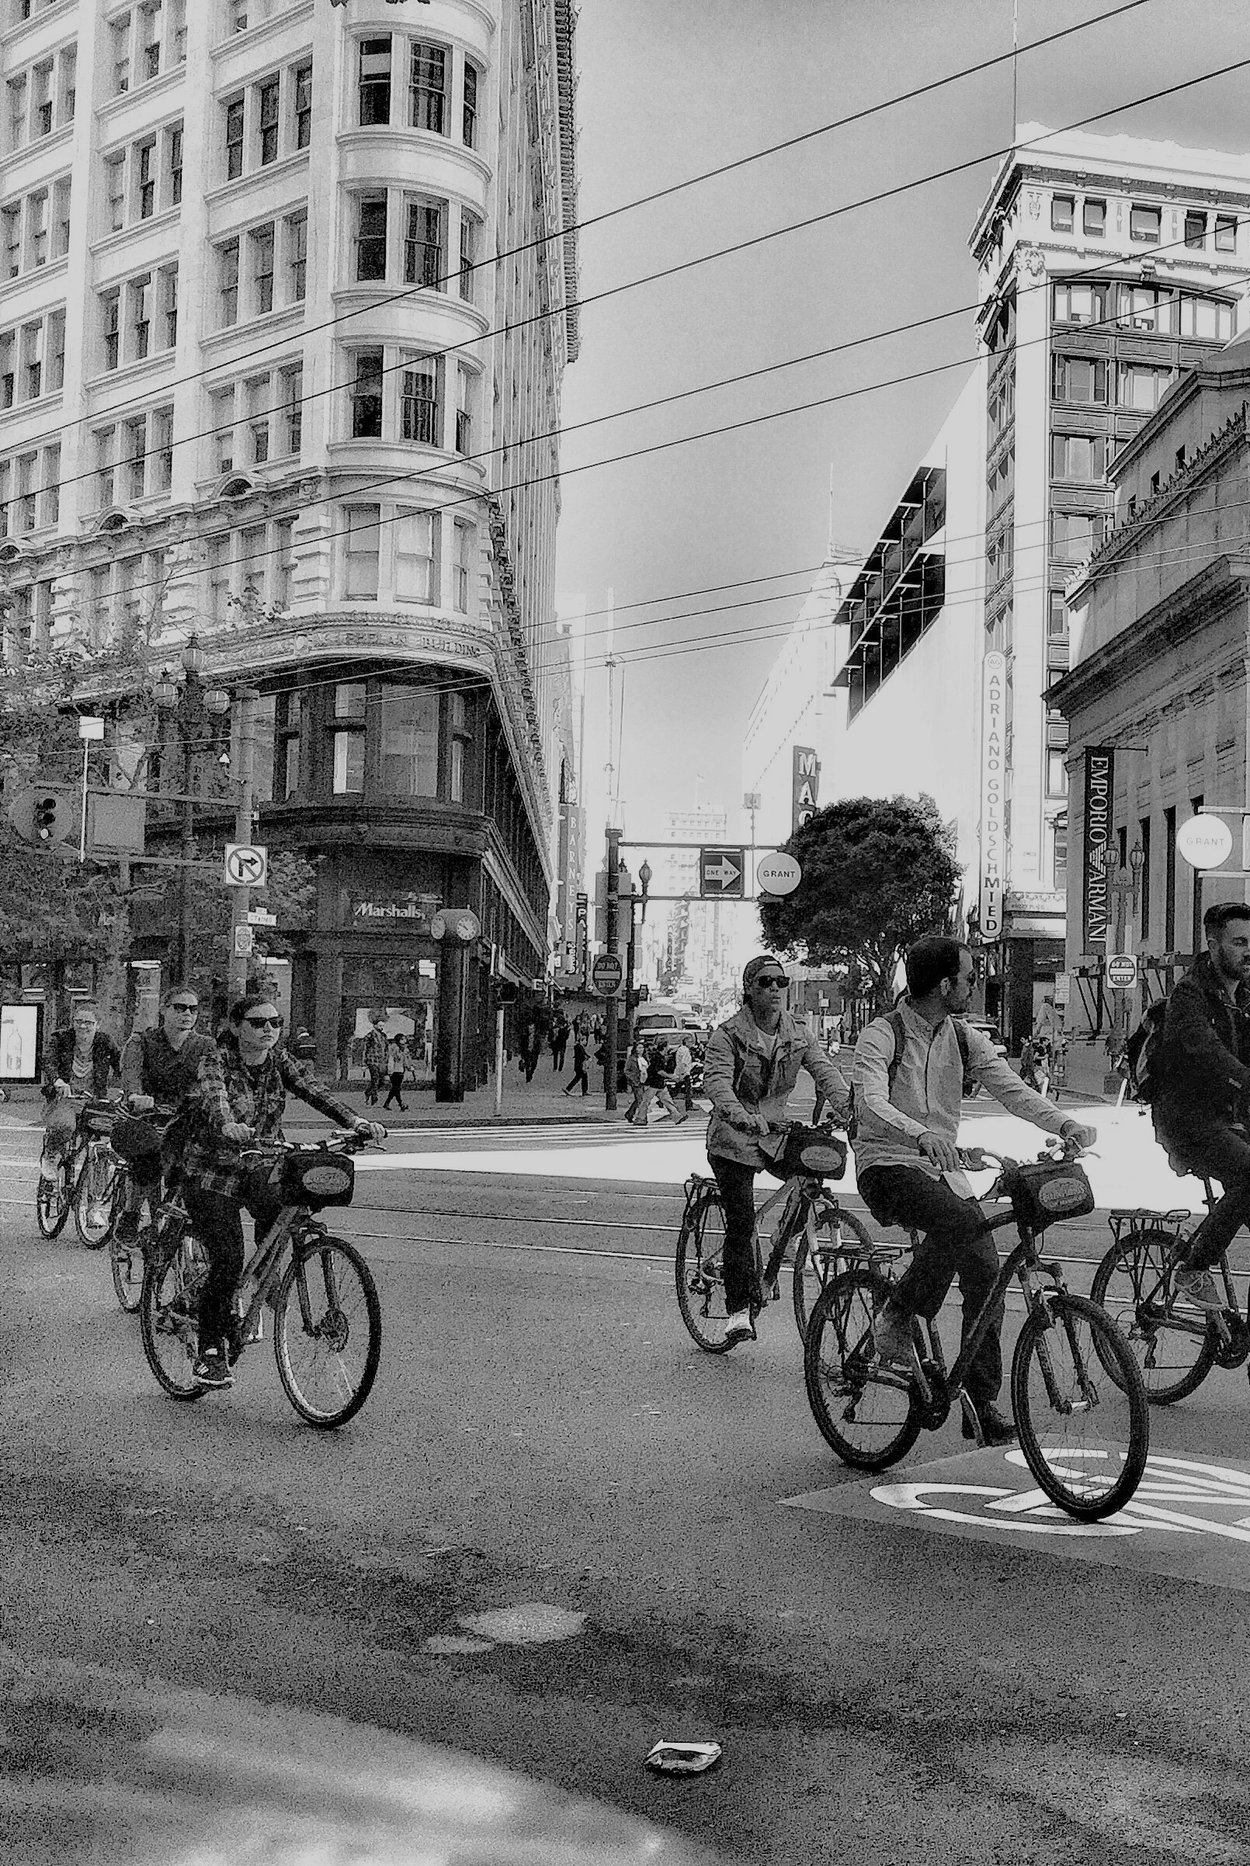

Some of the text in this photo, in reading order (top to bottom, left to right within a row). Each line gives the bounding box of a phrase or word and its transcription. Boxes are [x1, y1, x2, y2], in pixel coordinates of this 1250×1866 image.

[984, 675, 1001, 931] ADRIANO GOLDSCHMIED
[567, 816, 577, 930] BARNEYS
[763, 870, 796, 878] GRANT
[1088, 756, 1109, 943] EMPORIO ARMANI
[1186, 838, 1225, 846] GRANT
[354, 901, 421, 918] Marshalls
